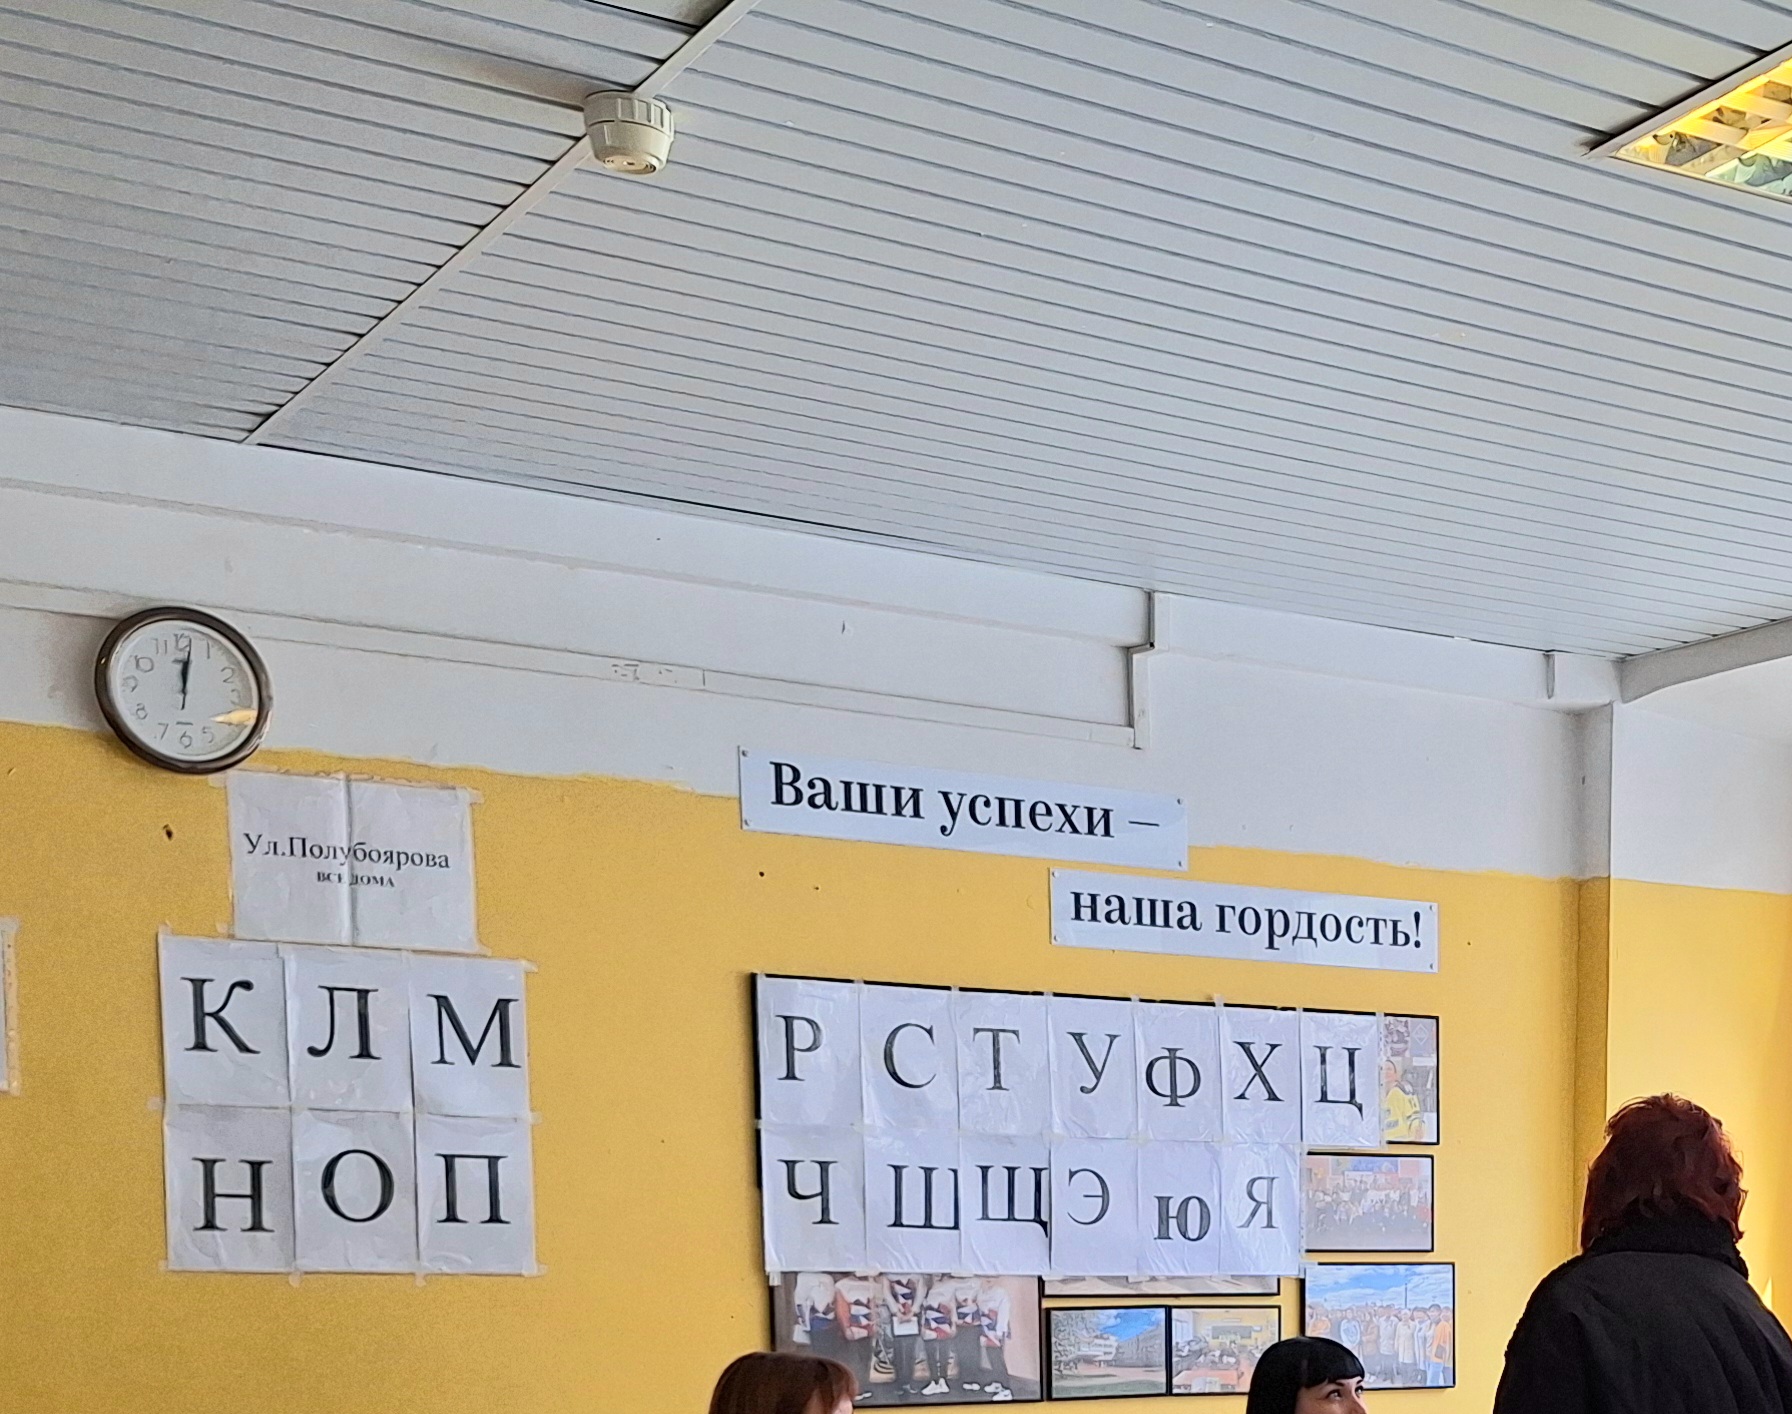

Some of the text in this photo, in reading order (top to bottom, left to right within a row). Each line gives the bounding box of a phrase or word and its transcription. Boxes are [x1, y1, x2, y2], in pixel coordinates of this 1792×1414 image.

[220, 666, 235, 684] 2
[135, 702, 148, 720] 8
[157, 722, 169, 740] 7
[202, 726, 215, 744] 5
[179, 730, 193, 749] 6
[770, 761, 925, 820] Ваши
[938, 791, 1115, 839] успехи
[243, 832, 451, 871] Ул.Полубоярова
[1070, 891, 1422, 952] наша гордость!
[181, 976, 522, 1069] К Л М
[775, 1014, 1363, 1117] Р С Т У Ф Х Ц
[192, 1148, 512, 1233] Н О П
[778, 1159, 839, 1225] Ч
[887, 1164, 961, 1231] Ш
[975, 1165, 1050, 1238] Щ
[1067, 1168, 1111, 1226] Э
[1242, 1176, 1277, 1229] Я
